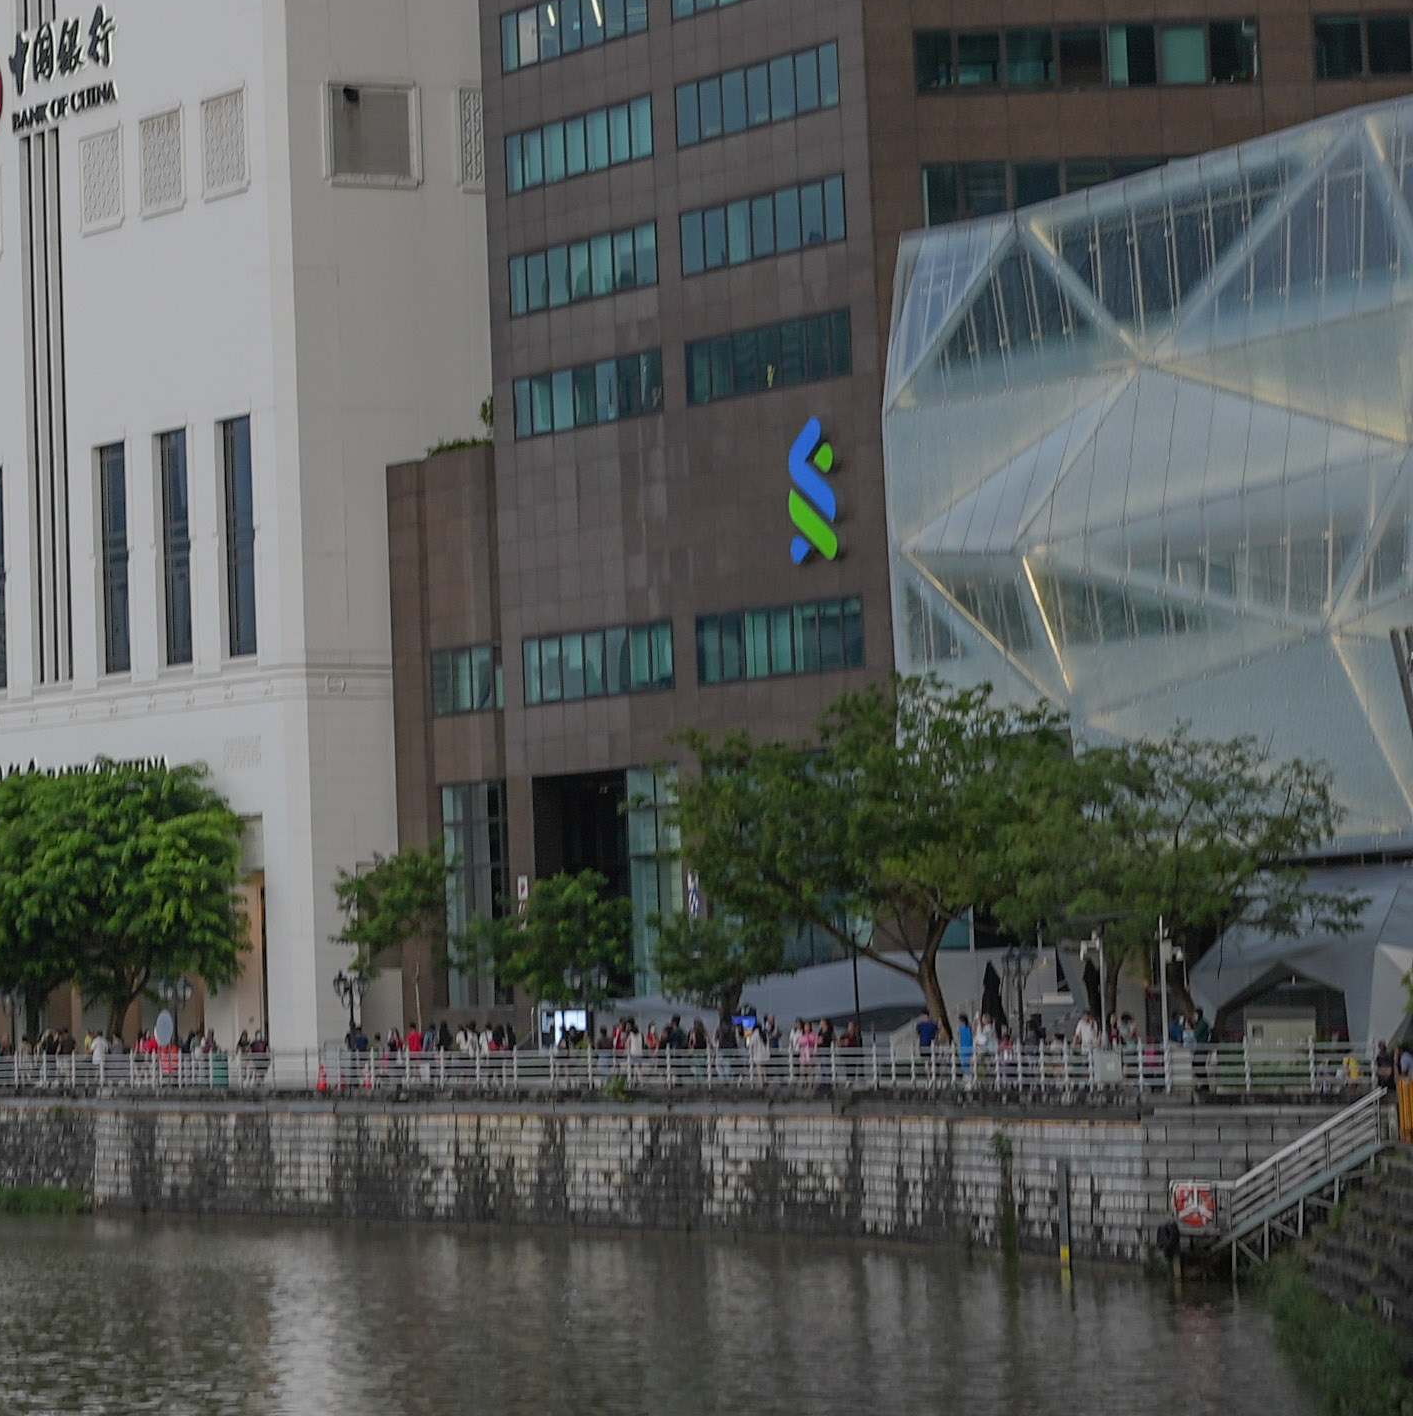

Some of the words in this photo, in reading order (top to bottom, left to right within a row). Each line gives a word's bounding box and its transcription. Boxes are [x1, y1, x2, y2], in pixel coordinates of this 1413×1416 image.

[11, 103, 50, 133] BANK
[50, 94, 69, 121] OF
[70, 80, 118, 114] CHINA
